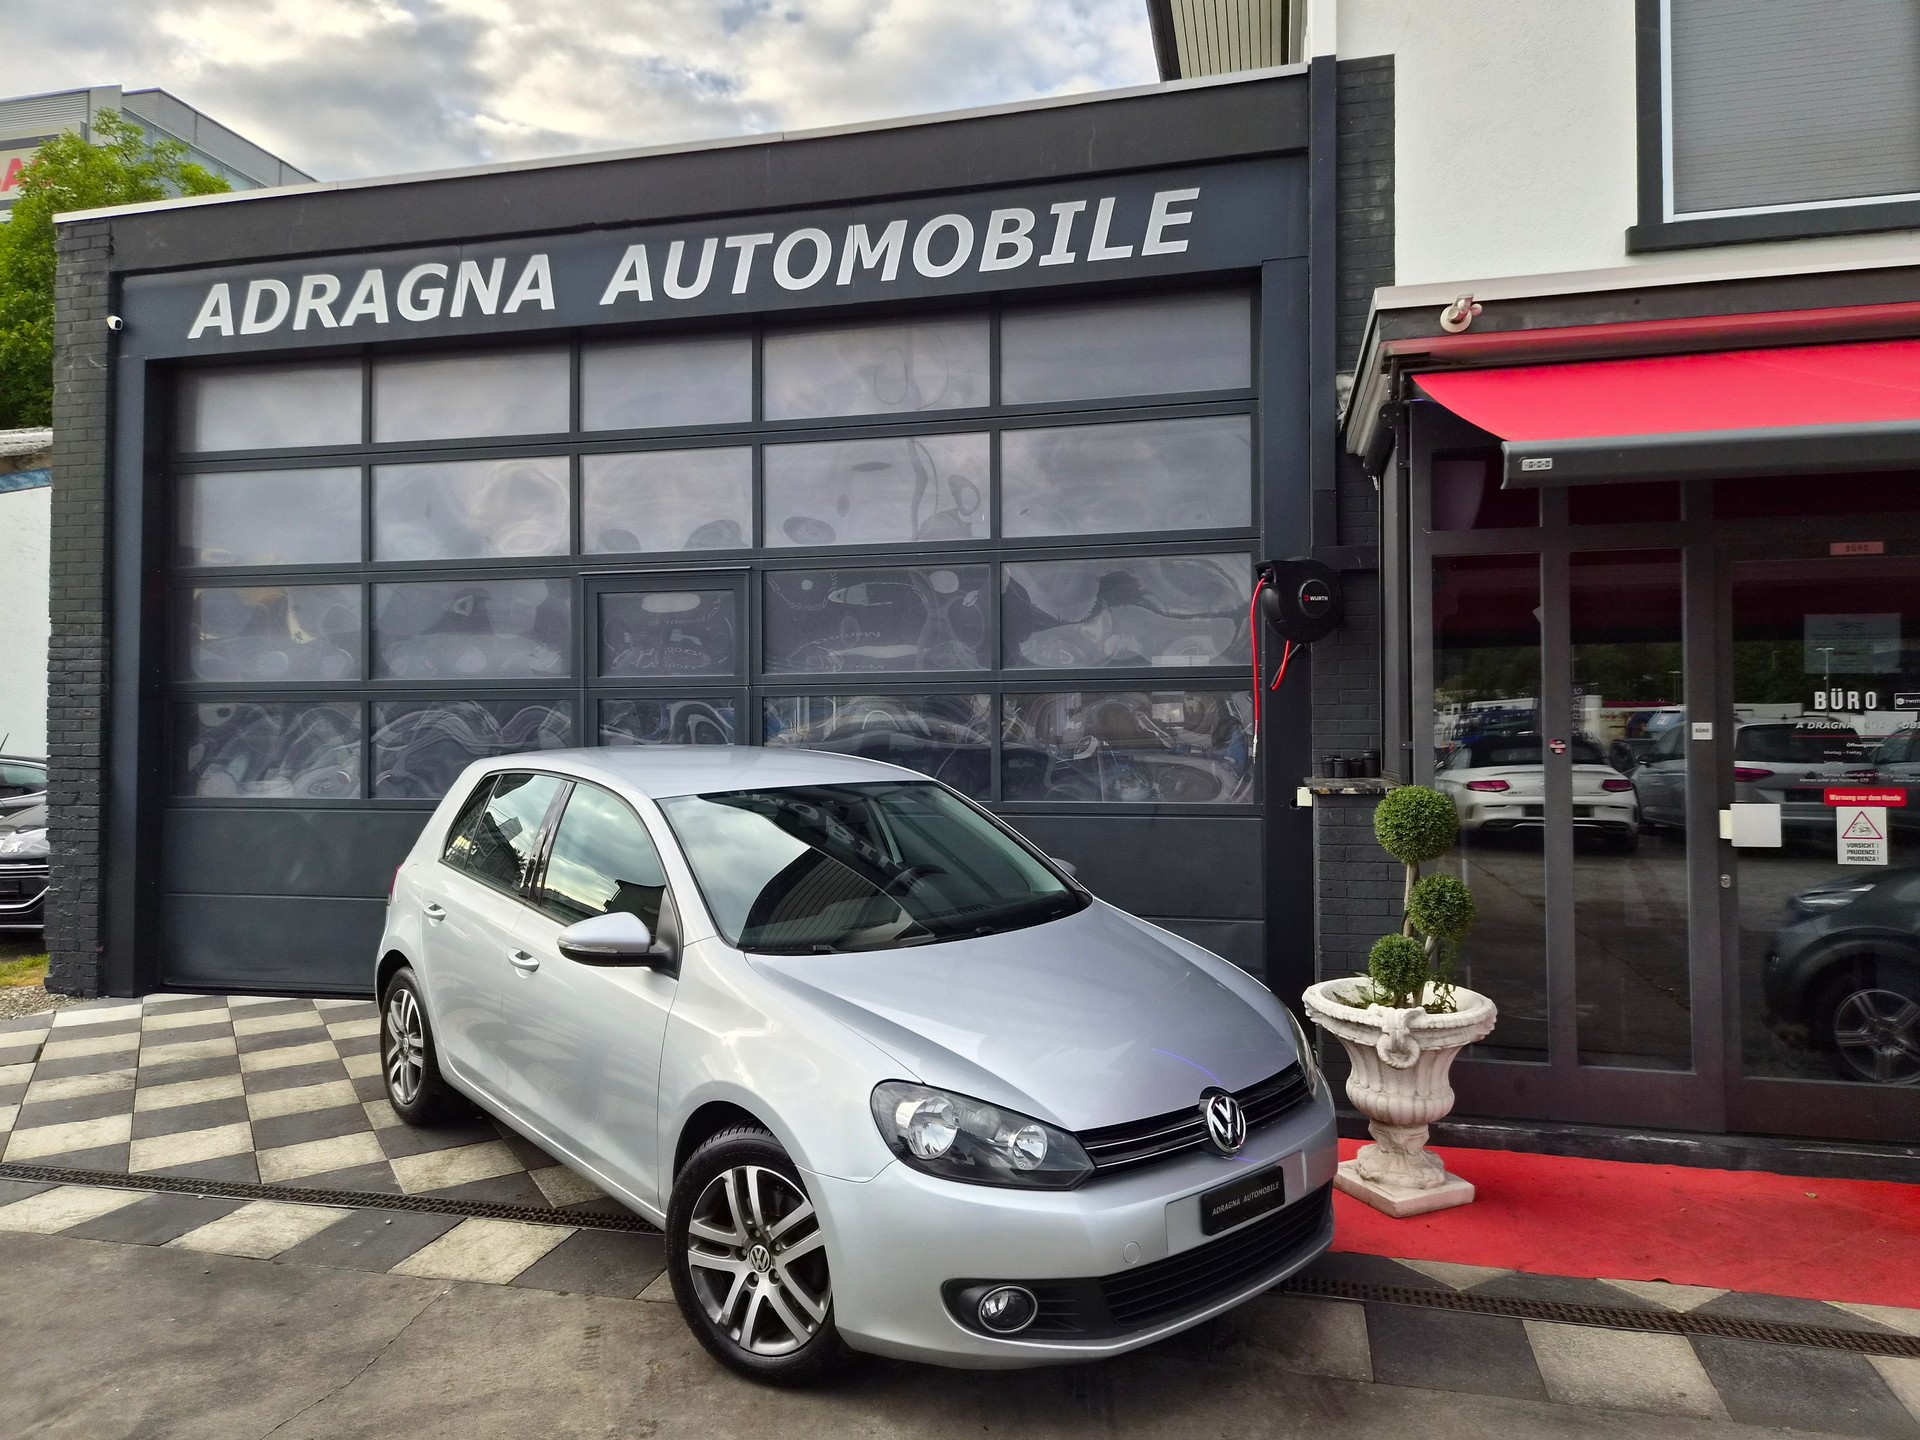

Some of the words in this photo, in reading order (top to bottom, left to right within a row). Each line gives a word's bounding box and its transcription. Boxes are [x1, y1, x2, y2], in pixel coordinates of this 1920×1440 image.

[187, 253, 556, 340] ADRAGNA
[598, 187, 1201, 306] AUTOMOBILE
[1814, 688, 1877, 710] BÜRO
[1828, 794, 1857, 802] Warnung
[1881, 794, 1903, 802] Hunde
[1211, 1198, 1241, 1217] ADRAGNA
[1242, 1181, 1280, 1203] AUTOMOBILE
